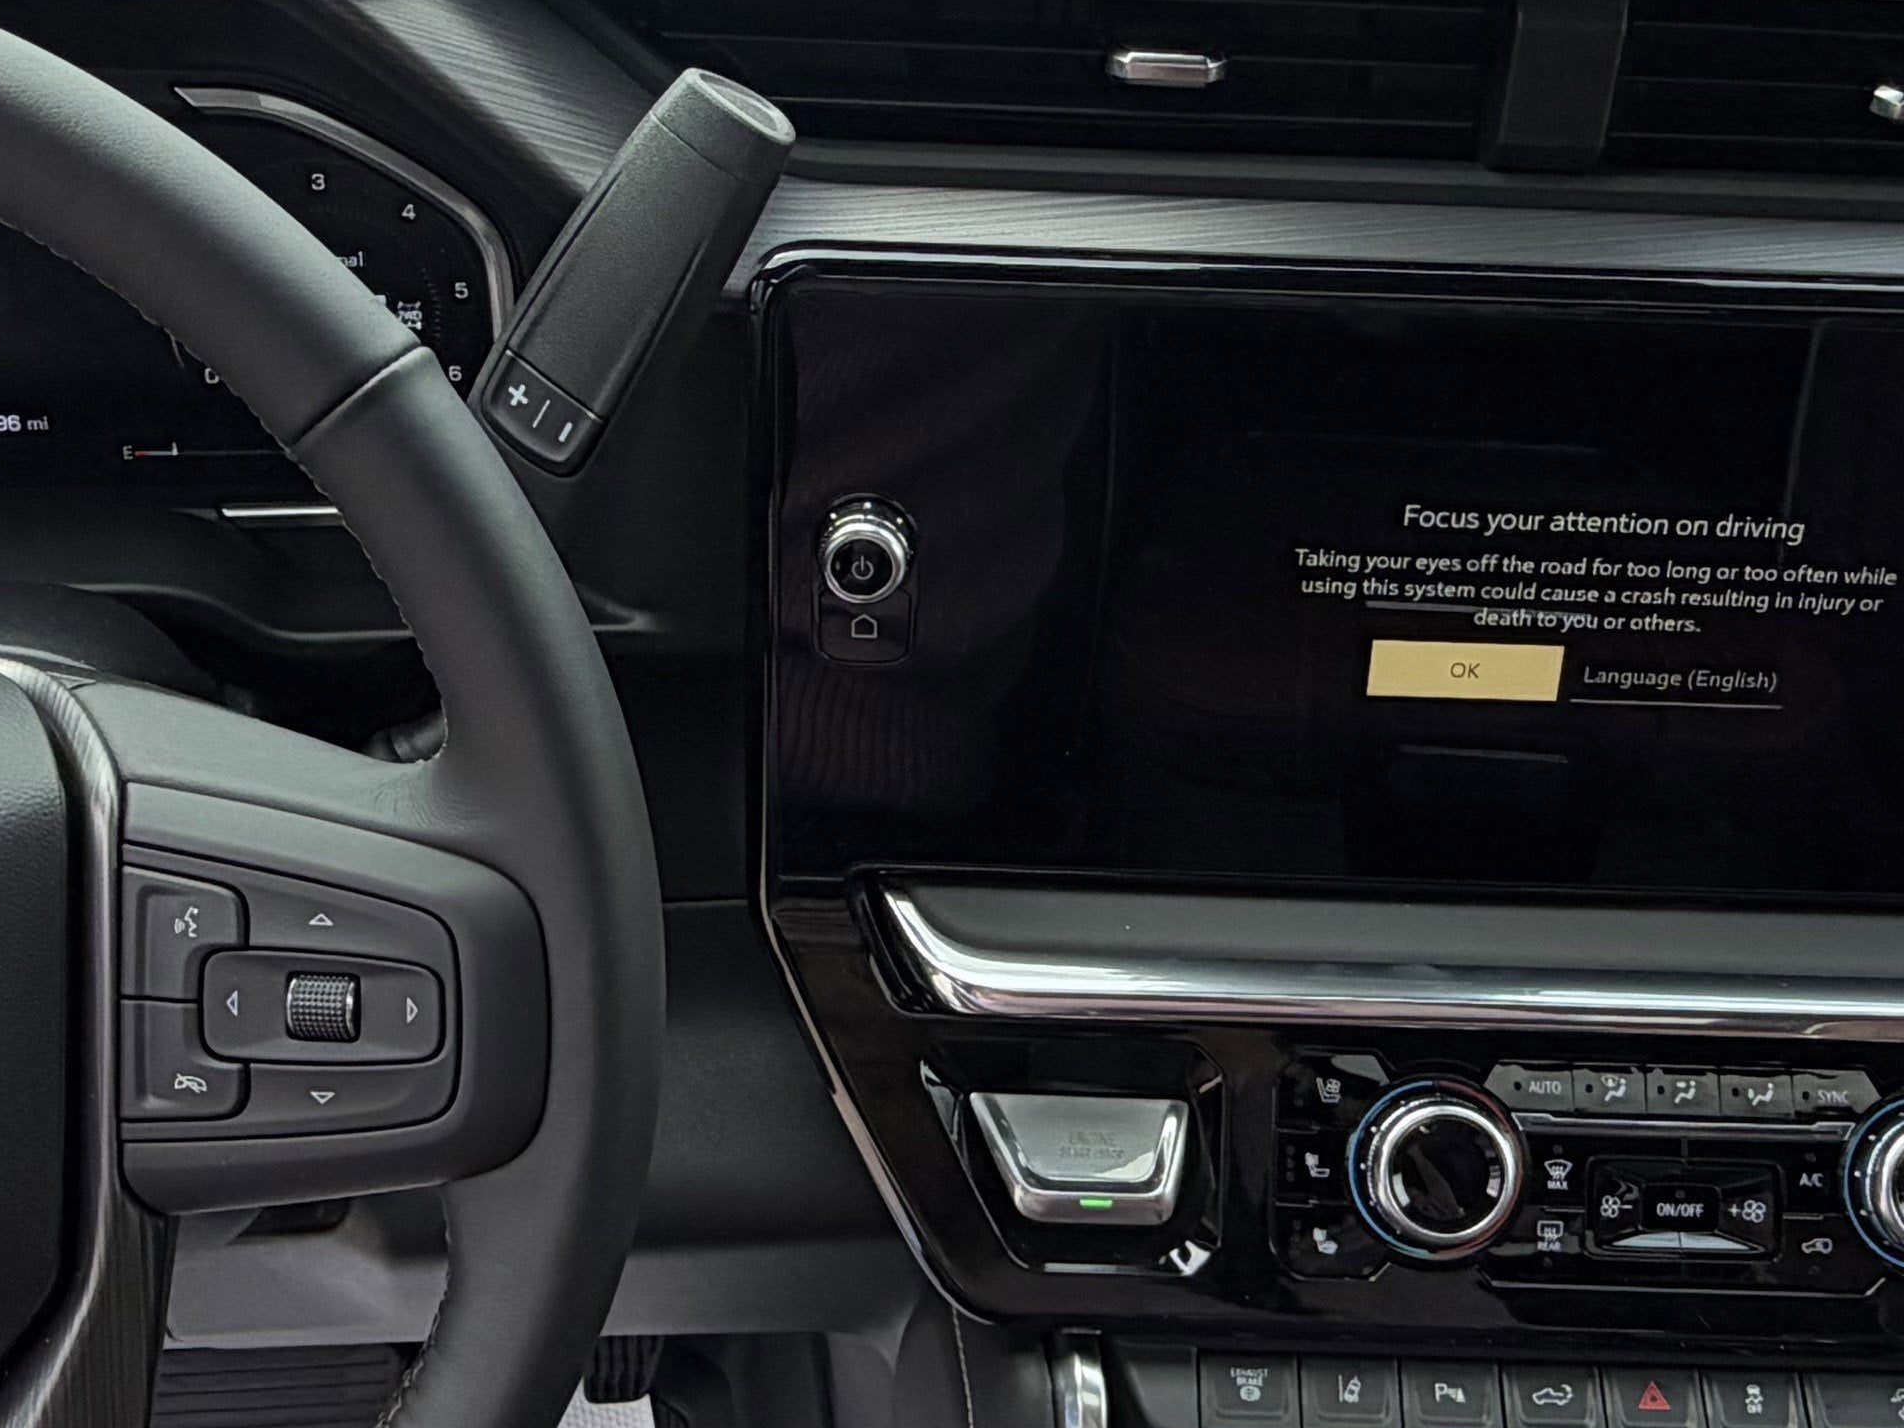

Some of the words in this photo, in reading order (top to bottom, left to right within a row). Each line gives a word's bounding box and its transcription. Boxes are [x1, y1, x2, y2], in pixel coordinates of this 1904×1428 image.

[311, 173, 325, 190] 3
[401, 204, 416, 221] 4
[454, 281, 469, 299] 5
[448, 365, 462, 382] 6
[27, 414, 49, 432] mi
[122, 444, 133, 461] E
[1403, 504, 1480, 530] Focus
[1484, 514, 1545, 536] your
[1549, 510, 1669, 536] attention
[1675, 518, 1709, 536] on
[1715, 514, 1805, 545] driving
[1295, 549, 1361, 573] Taking
[1364, 555, 1412, 574] your
[1415, 557, 1462, 576] eyes
[1466, 553, 1499, 571] off
[1502, 555, 1535, 573] the
[1540, 556, 1587, 574] road
[1592, 557, 1623, 577] for
[1627, 559, 1661, 577] too
[1664, 560, 1711, 582] long
[1716, 565, 1740, 580] or
[1743, 563, 1778, 581] too
[1783, 564, 1838, 584] often
[1844, 566, 1897, 586] while
[1301, 577, 1357, 598] using
[1362, 578, 1399, 596] this
[1404, 583, 1476, 604] system
[1480, 582, 1536, 601] could
[1541, 587, 1600, 603] cause
[1603, 590, 1616, 604] a
[1620, 587, 1676, 606] crash
[1681, 590, 1770, 612] resulting
[1774, 591, 1793, 609] in
[1798, 593, 1856, 617] injury
[1859, 596, 1884, 611] or
[1473, 606, 1532, 627] death
[1536, 612, 1558, 628] to
[1561, 614, 1598, 634] you
[1603, 616, 1626, 631] or
[1630, 614, 1701, 633] others.
[1449, 661, 1481, 680] OK
[1583, 665, 1682, 691] Language
[1687, 668, 1778, 694] (English)
[1528, 1080, 1563, 1095] AUTO
[1817, 1089, 1851, 1105] SYNC
[1799, 1172, 1824, 1188] A/C
[1656, 1202, 1705, 1218] ON/OFF
